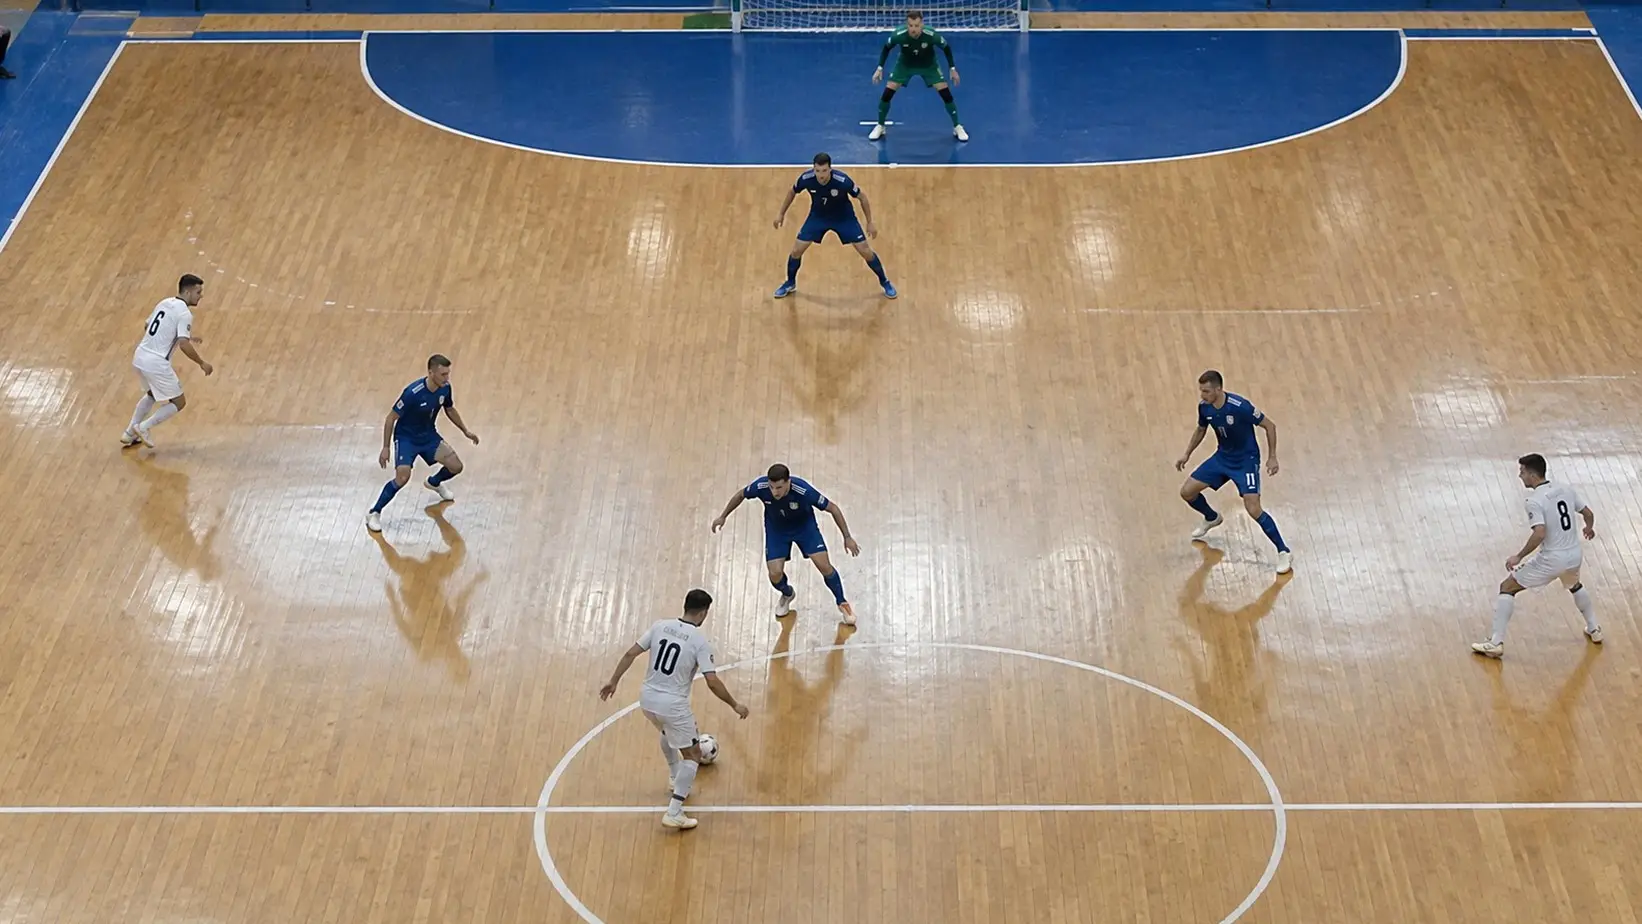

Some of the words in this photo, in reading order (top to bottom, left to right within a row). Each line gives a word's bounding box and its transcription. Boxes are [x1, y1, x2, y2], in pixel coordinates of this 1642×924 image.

[149, 311, 165, 336] 6
[1246, 473, 1256, 486] 11
[1557, 500, 1571, 531] 8
[653, 638, 681, 676] 10
